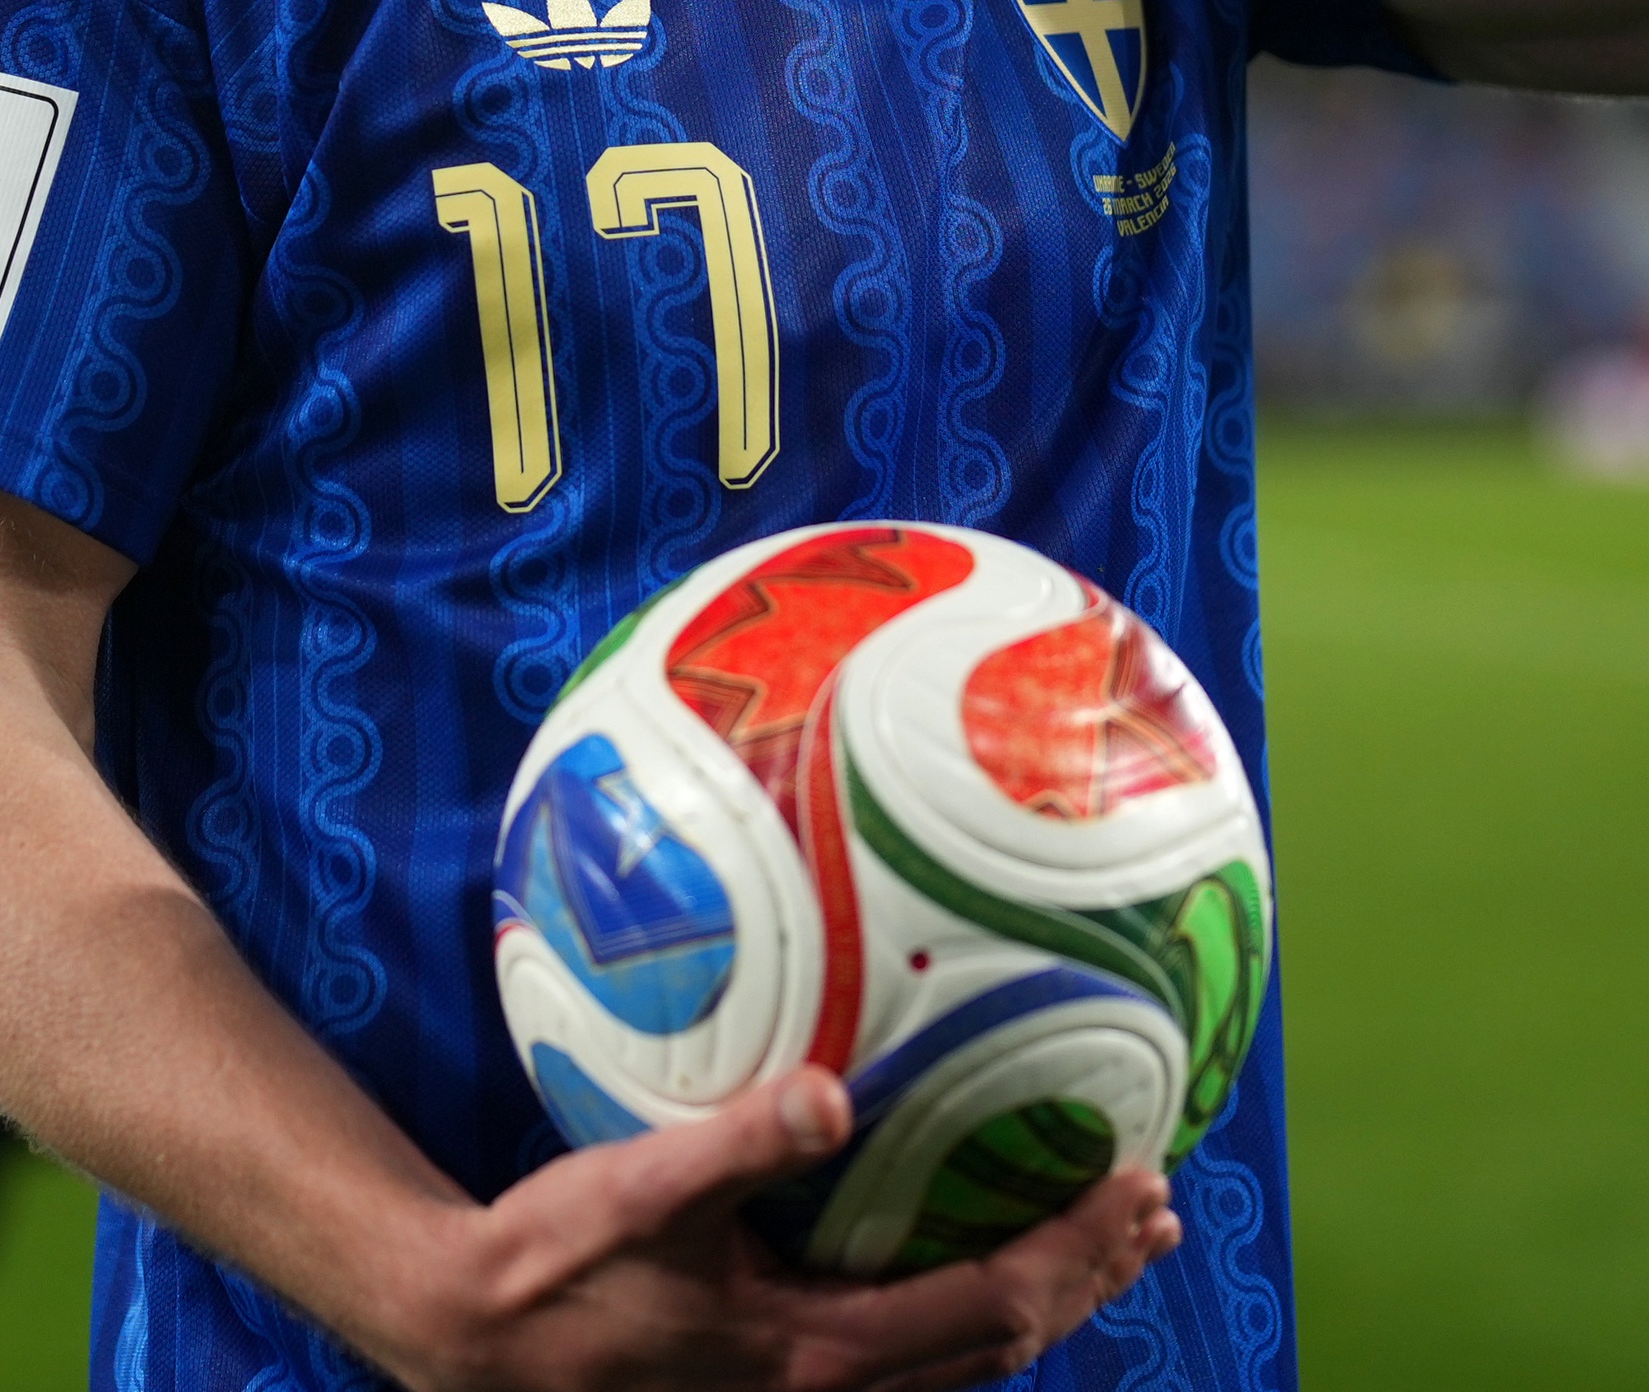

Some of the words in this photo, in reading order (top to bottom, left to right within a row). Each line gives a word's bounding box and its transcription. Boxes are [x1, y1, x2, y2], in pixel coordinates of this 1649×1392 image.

[1112, 192, 1154, 216] MARCH
[1116, 195, 1169, 237] VALENCIA
[431, 142, 780, 514] 17
